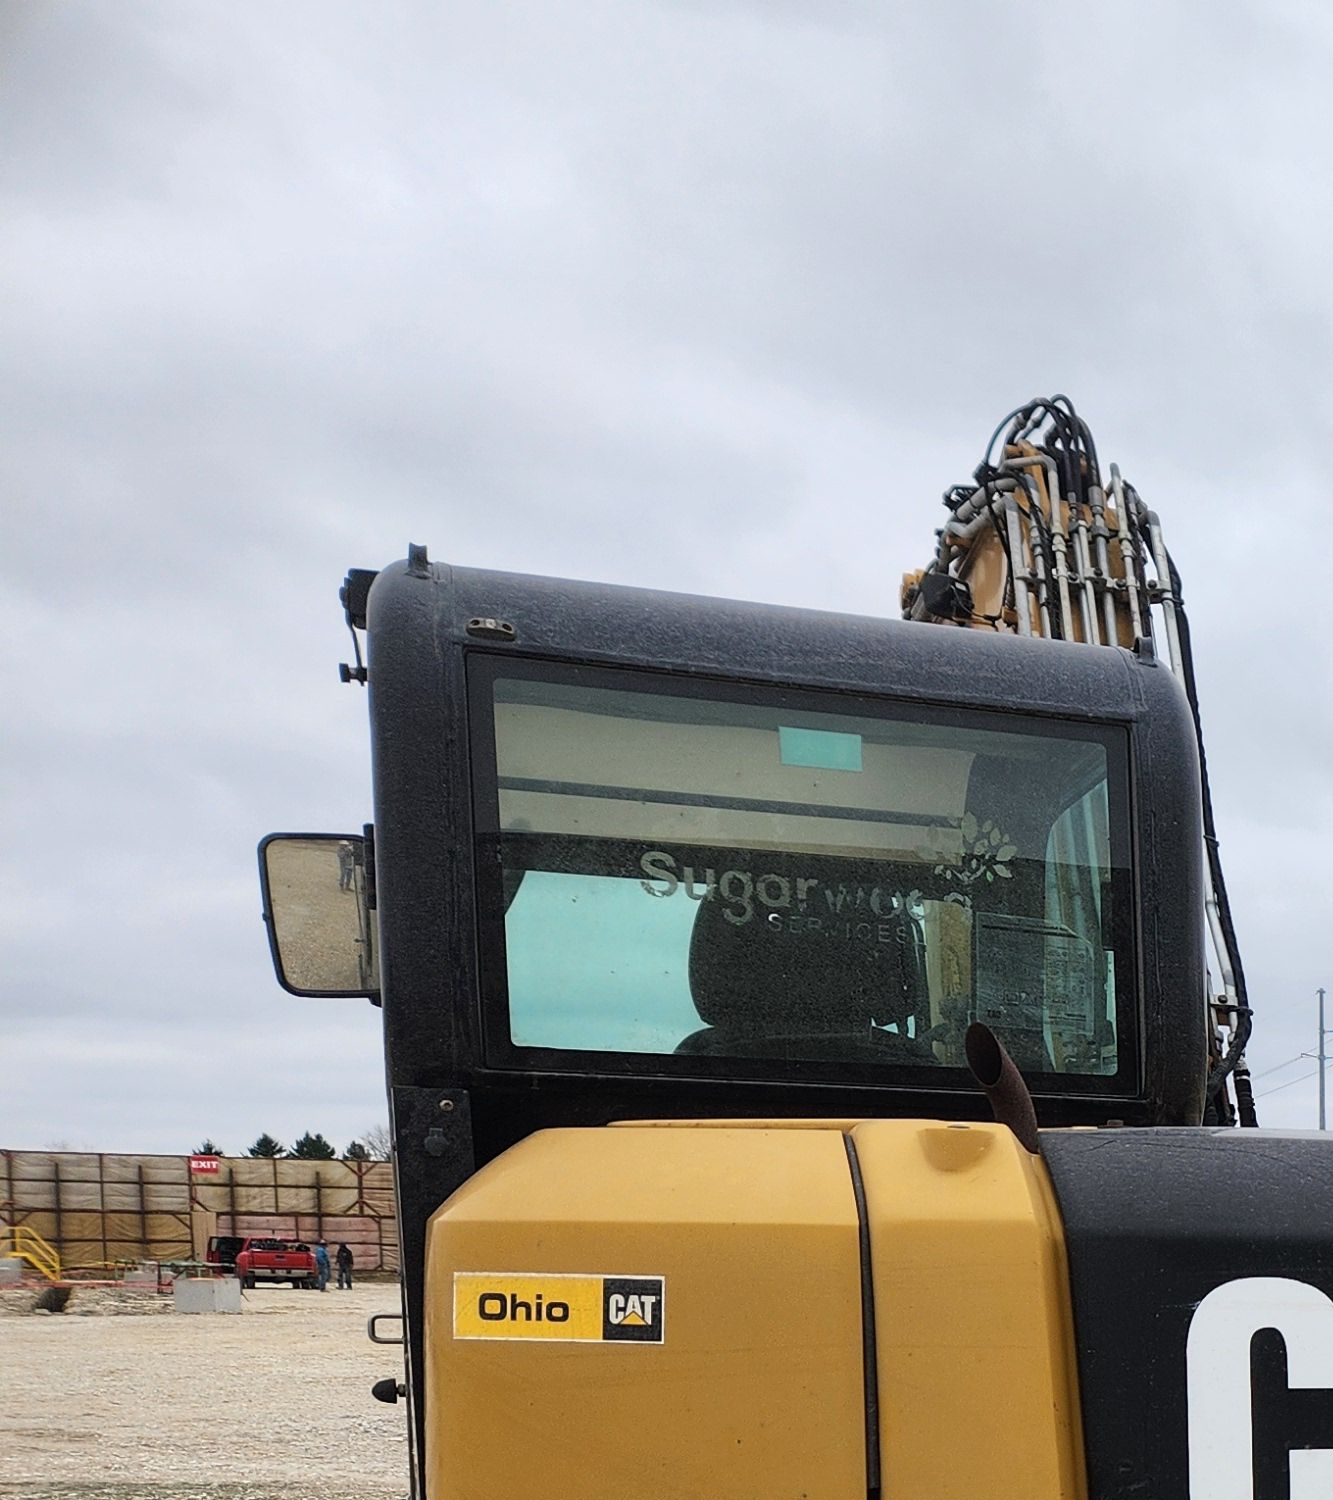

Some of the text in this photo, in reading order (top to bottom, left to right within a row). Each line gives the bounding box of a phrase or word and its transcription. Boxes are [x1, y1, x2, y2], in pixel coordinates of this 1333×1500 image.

[191, 1160, 218, 1169] EXIT
[478, 1292, 656, 1326] Ohio CAT
